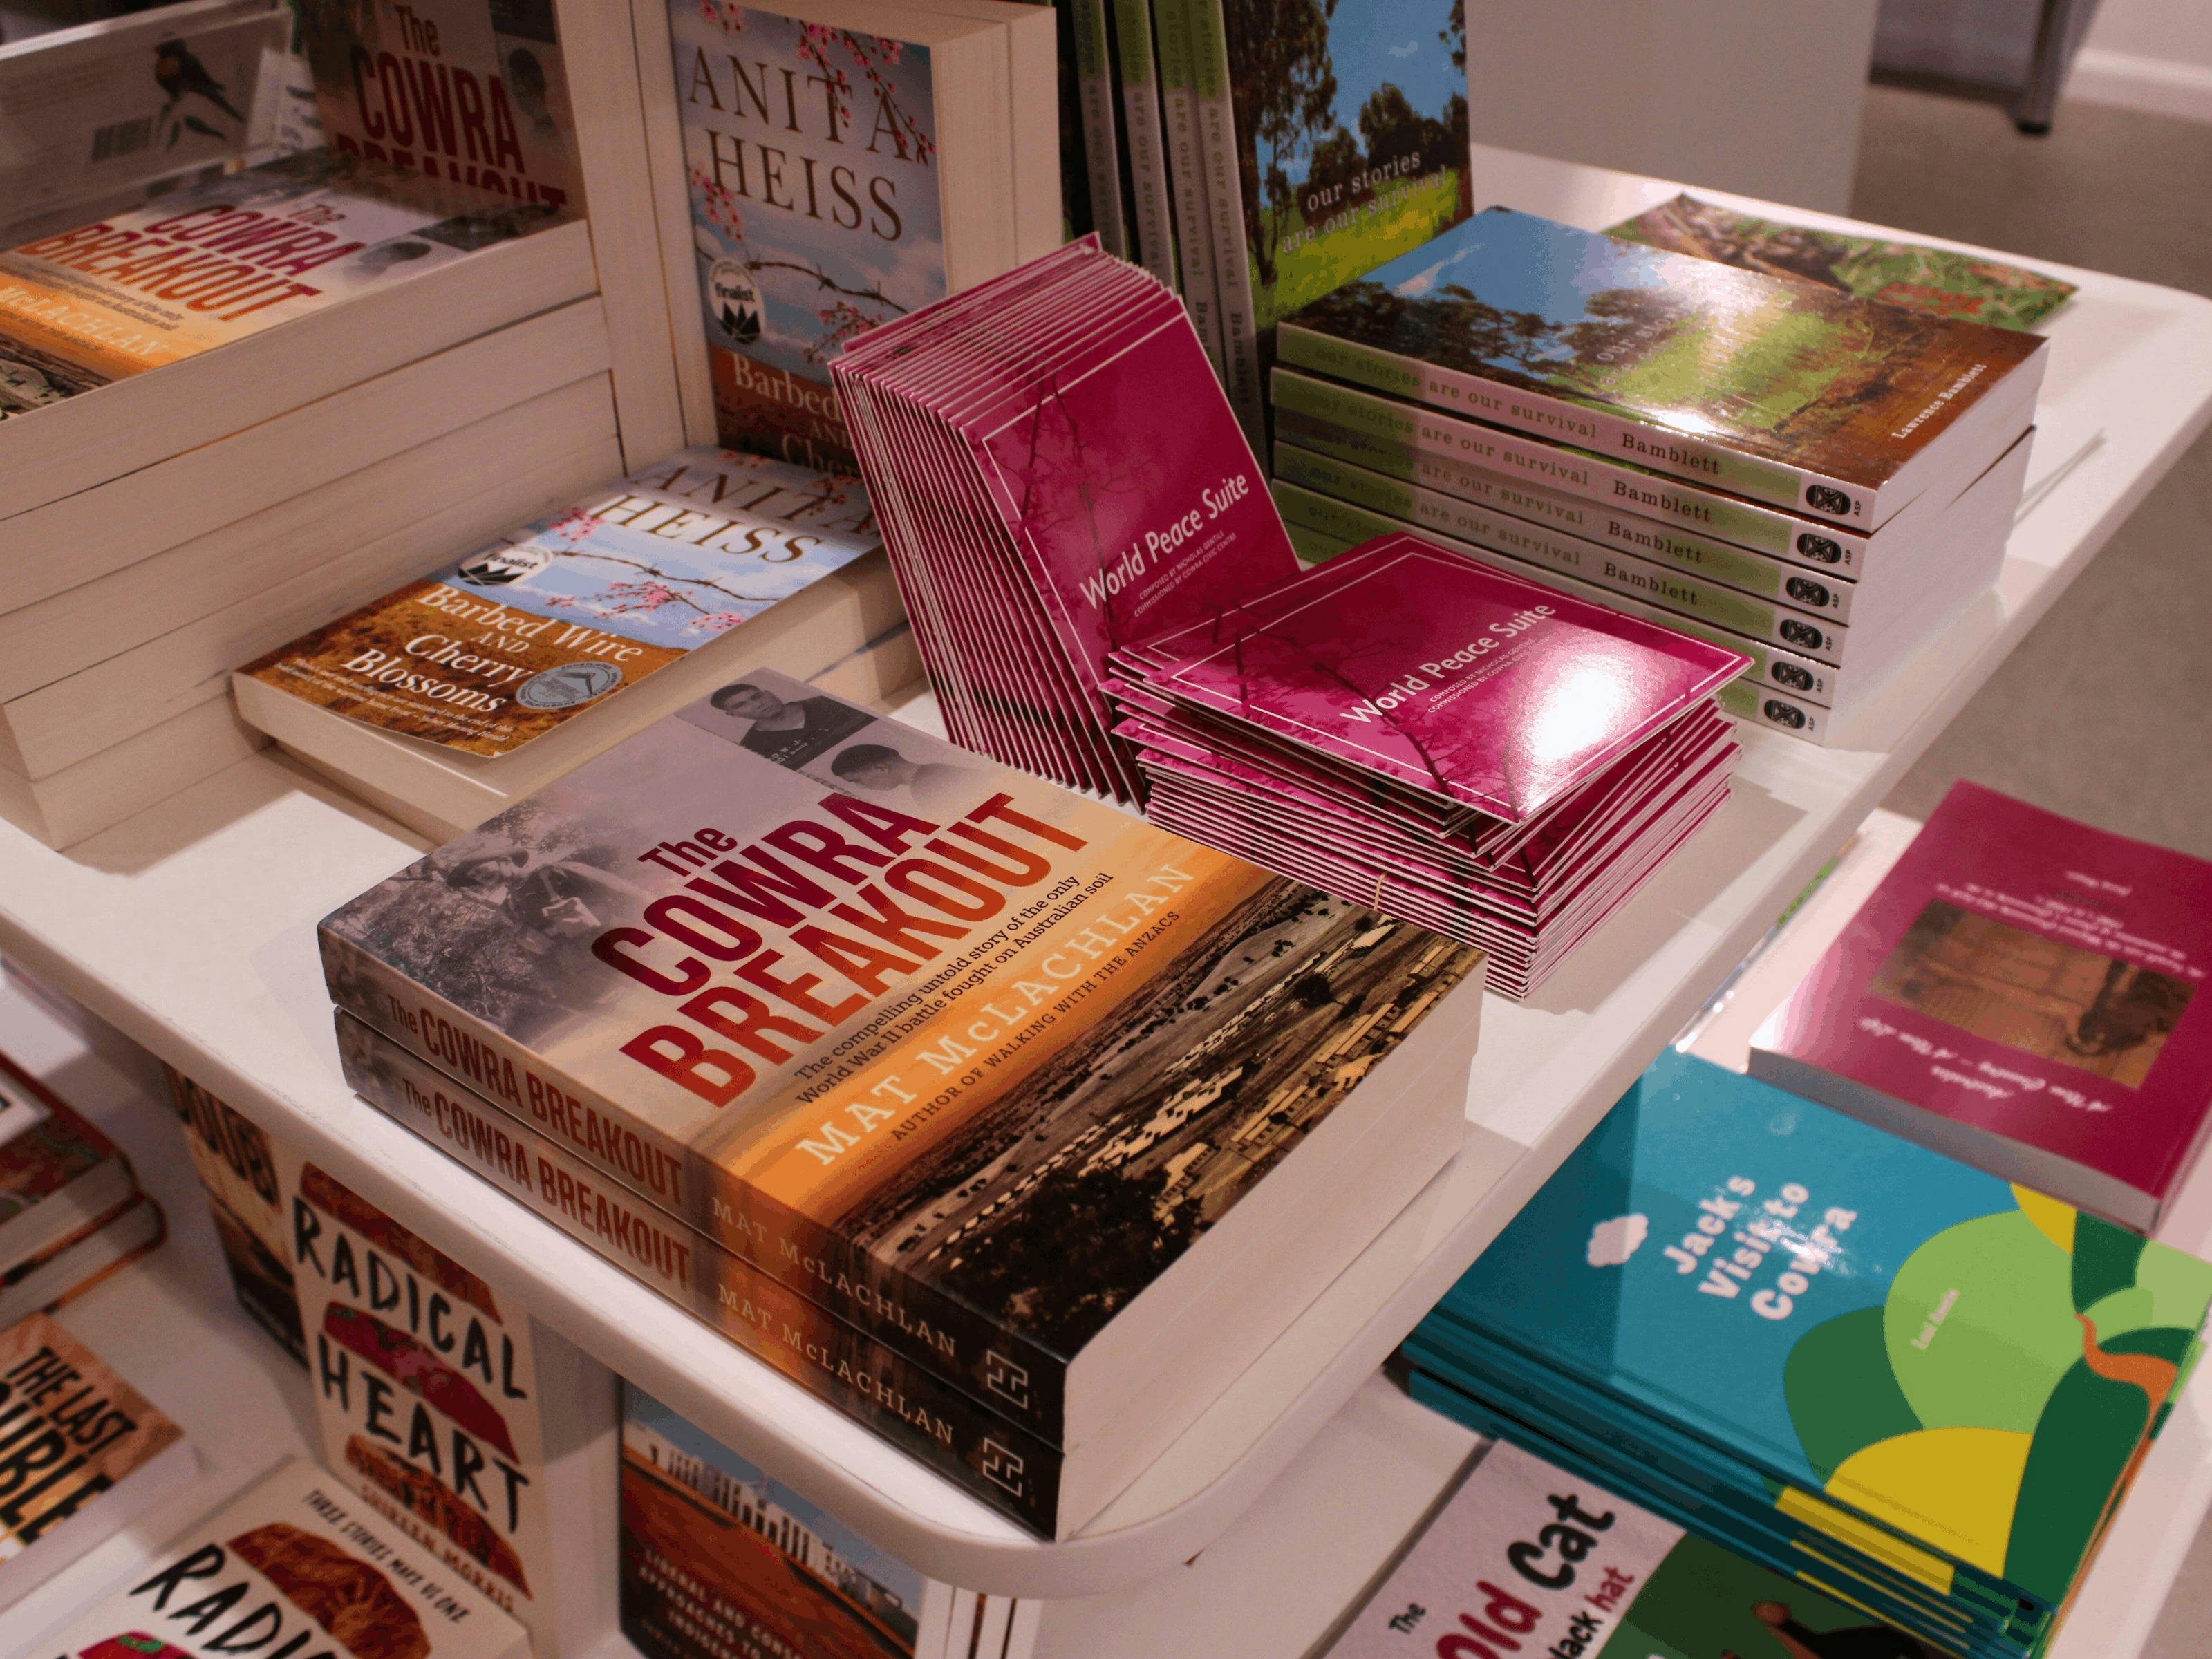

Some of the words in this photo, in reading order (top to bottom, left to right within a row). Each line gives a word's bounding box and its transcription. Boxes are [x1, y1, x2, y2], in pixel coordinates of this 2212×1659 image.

[395, 5, 441, 56] The
[349, 44, 525, 175] COWRA
[688, 45, 912, 162] ANITA
[706, 128, 902, 242] HEISS
[1179, 141, 1194, 180] our
[1214, 150, 1227, 189] our
[1282, 225, 1316, 255] are
[1323, 206, 1360, 236] our
[1367, 163, 1447, 217] survival
[1306, 182, 1344, 212] our
[1351, 149, 1422, 195] stories
[15, 223, 324, 322] BREAKOUT
[142, 204, 366, 276] COWRA
[1184, 187, 1205, 276] survival
[1218, 198, 1239, 288] survival
[732, 353, 842, 424] Barbed
[1428, 378, 1461, 399] are
[1468, 392, 1503, 411] our
[1510, 404, 1597, 438] survival
[1621, 432, 1721, 477] Bamblett
[1891, 400, 1945, 440] Lawrence
[1938, 364, 1988, 400] Bamblett
[630, 465, 881, 537] ANITA
[1421, 426, 1453, 444] are
[1461, 438, 1495, 457] our
[1503, 450, 1590, 486] survival
[1613, 479, 1712, 523] Bamblett
[1421, 462, 1451, 479] are
[1459, 476, 1494, 496] our
[1499, 488, 1584, 525] survival
[1607, 520, 1703, 565] Bamblett
[588, 494, 825, 563] HEISS
[1078, 541, 1147, 610] World
[1145, 509, 1203, 563] Peace
[1201, 474, 1249, 520] Suite
[1139, 574, 1169, 600] COMPOSED
[1168, 567, 1176, 577] BY
[1176, 546, 1203, 571] NICHOLAS
[1419, 503, 1450, 522] are
[1456, 515, 1490, 534] our
[1497, 528, 1580, 565] survival
[1603, 561, 1698, 606] Bamblett
[417, 584, 557, 639] Barbed
[554, 624, 645, 663] Wire
[1134, 581, 1175, 617] COMMISSIONED
[1174, 575, 1183, 585] BY
[1182, 560, 1203, 579] COWRA
[344, 648, 508, 713] Blossoms
[404, 633, 536, 688] Cherry
[471, 630, 531, 654] AND
[1338, 674, 1430, 724] World
[1419, 636, 1500, 679] Peace
[1489, 603, 1557, 638] Suite
[1427, 681, 1479, 713] COMMISSIONED
[1477, 675, 1488, 684] BY
[1488, 661, 1514, 677] COWRA
[1430, 679, 1468, 702] COMPOSED
[1465, 673, 1476, 681] BY
[1476, 654, 1508, 675] NICHOLAS
[590, 791, 942, 997] COWRA
[637, 825, 739, 878] The
[618, 791, 1089, 1109] BREAKOUT
[793, 1055, 834, 1082] The
[832, 990, 924, 1056] compelling
[919, 957, 972, 995] untold
[968, 929, 1010, 962] story
[1006, 915, 1025, 933] of
[1019, 899, 1050, 923] the
[1045, 874, 1081, 905] only
[795, 1067, 854, 1105] World
[852, 1043, 890, 1073] War
[882, 1031, 903, 1048] II
[897, 998, 948, 1035] battle
[941, 959, 999, 1004] fought
[995, 946, 1019, 964] on
[1014, 894, 1089, 950] Australian
[1085, 872, 1115, 896] soil
[794, 1074, 917, 1167] MAT
[915, 863, 1194, 1076] McLACHLAN
[890, 1083, 964, 1143] AUTHOR
[960, 1065, 985, 1087] OF
[983, 1011, 1057, 1071] WALKING
[1052, 980, 1098, 1014] WITH
[1094, 957, 1127, 984] THE
[1125, 910, 1181, 958] ANZACS
[388, 994, 419, 1035] The
[420, 1006, 525, 1109] COWRA
[524, 1069, 682, 1206] BREAKOUT
[711, 1197, 768, 1244] MAT
[779, 1237, 957, 1358] McLACHLAN
[402, 1077, 431, 1118] The
[433, 1091, 534, 1194] COWRA
[537, 1154, 691, 1292] BREAKOUT
[718, 1282, 771, 1331] MAT
[782, 1322, 954, 1445] McLACHLAN
[1696, 1220, 1782, 1300] Visit
[1763, 1182, 1810, 1219] to
[1750, 1206, 1859, 1321] Cowra
[292, 1194, 527, 1400] RADICAL
[6, 1345, 81, 1407] THE
[49, 1384, 138, 1456] LAST
[317, 1333, 530, 1535] HEART
[1507, 1493, 1617, 1591] Cat
[130, 1543, 337, 1659] RADI
[434, 1596, 474, 1624] ONE
[1389, 1602, 1427, 1635] The
[1548, 1610, 1604, 1659] lack
[1584, 1566, 1637, 1613] hat
